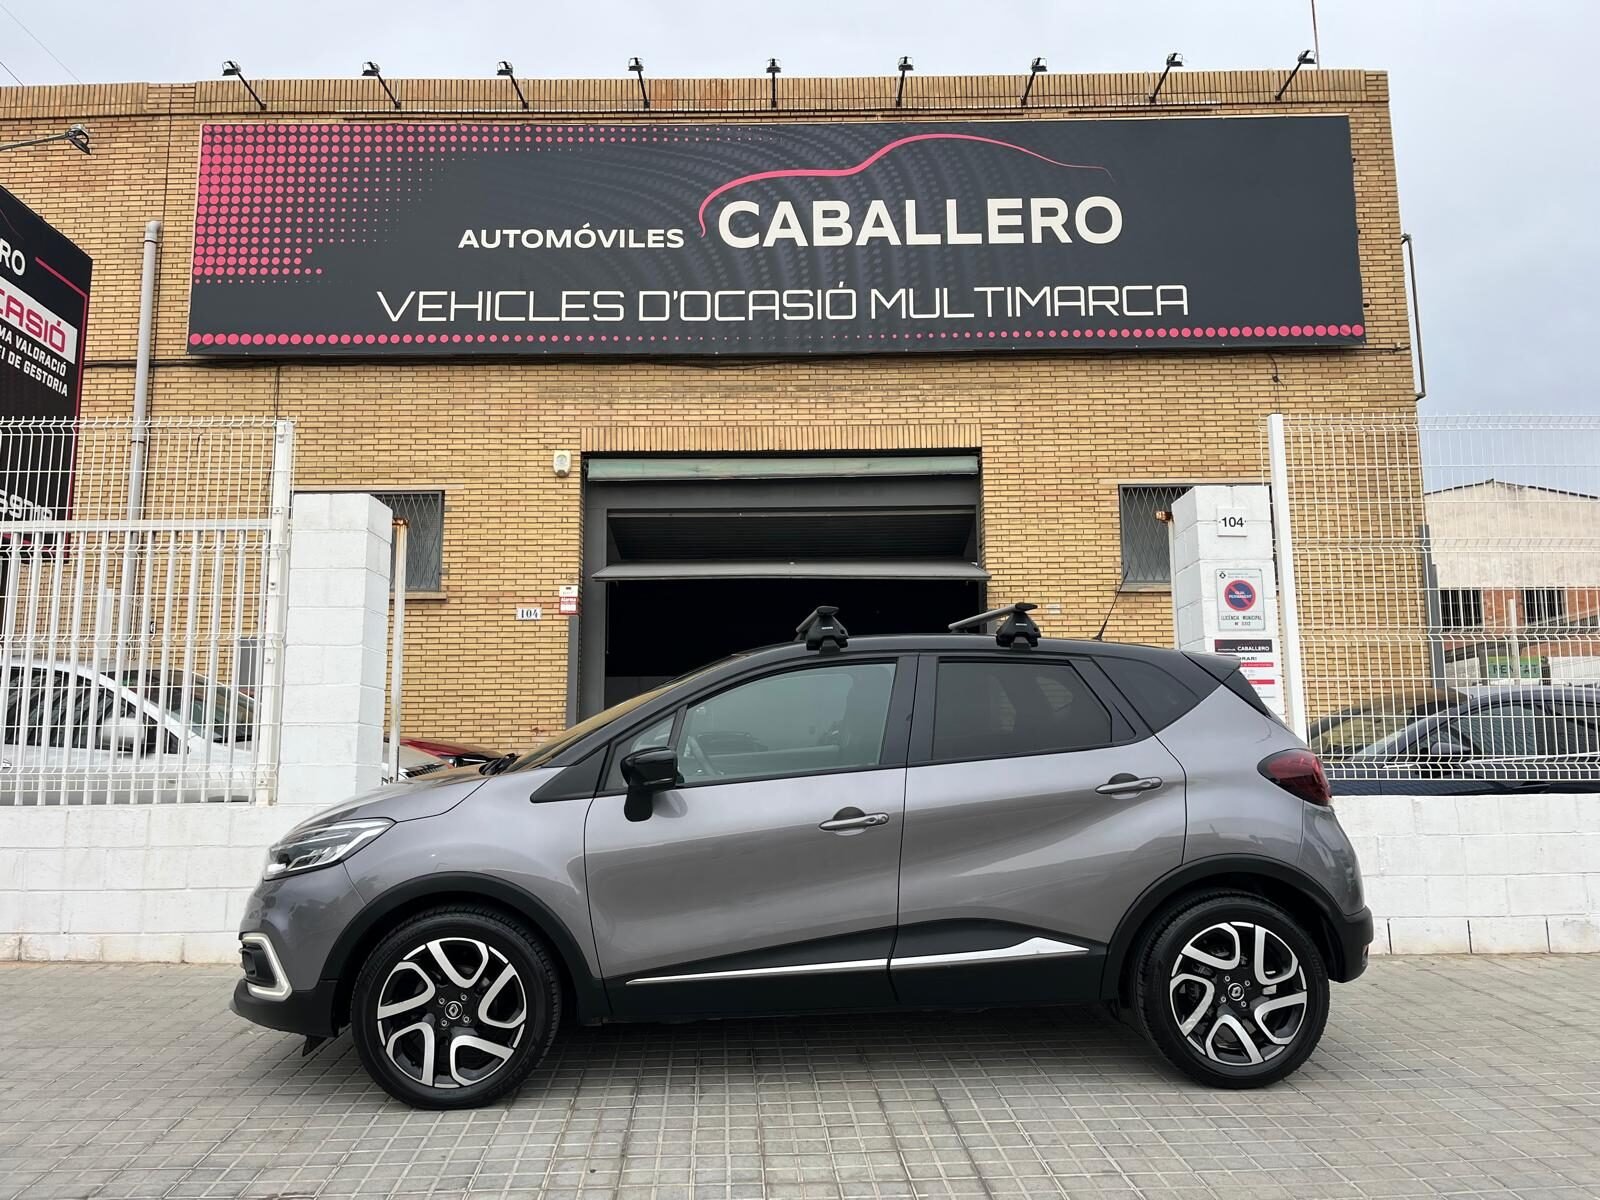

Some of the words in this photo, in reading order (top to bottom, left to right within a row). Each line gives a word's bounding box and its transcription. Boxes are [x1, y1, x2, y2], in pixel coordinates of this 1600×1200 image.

[458, 222, 685, 249] AUTOMÓVILES
[718, 196, 1123, 248] CABALLERO
[376, 290, 625, 322] VEHICLES
[638, 281, 857, 322] D'OCASIÓ
[871, 284, 1189, 320] MULTIMARCA
[8, 351, 21, 370] DE
[23, 361, 68, 397] GESTORIA
[15, 335, 67, 377] VALORACIÓ
[1221, 516, 1244, 528] 104
[521, 609, 538, 619] 104
